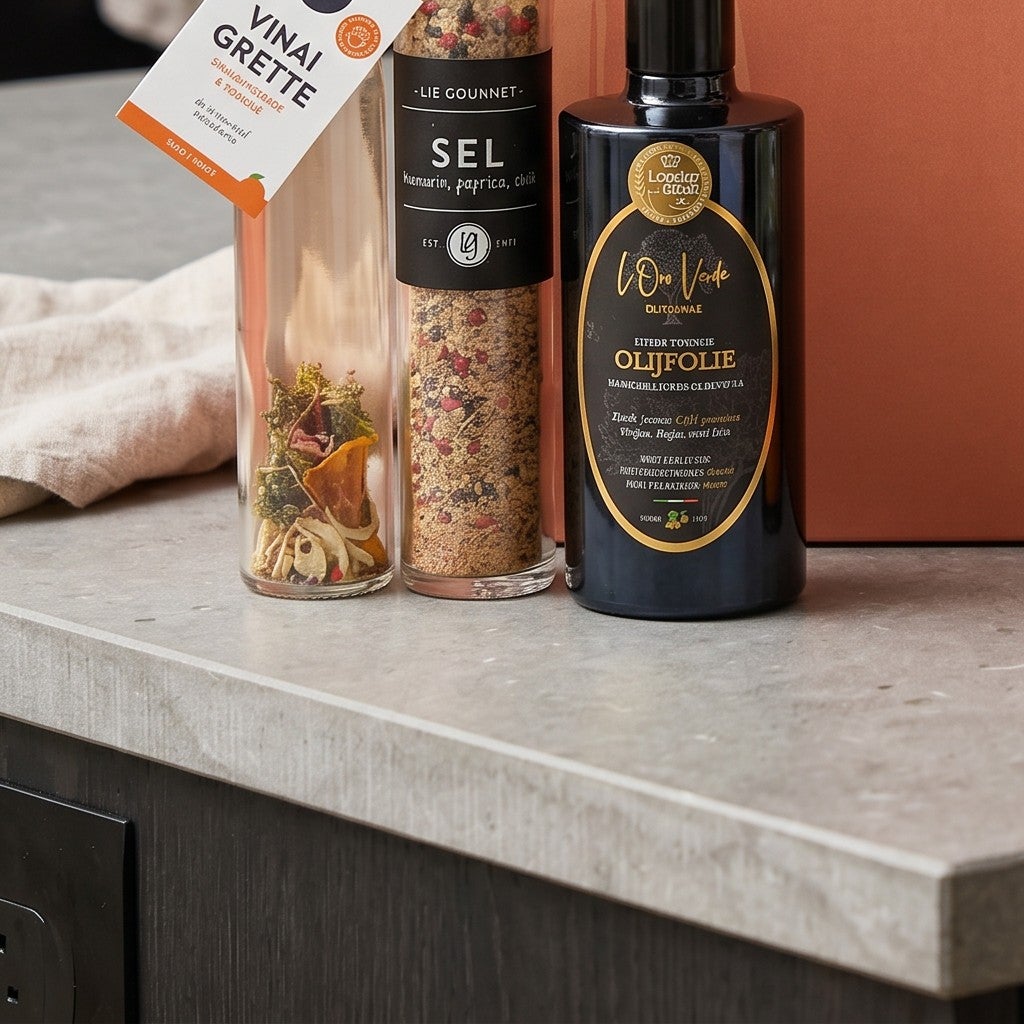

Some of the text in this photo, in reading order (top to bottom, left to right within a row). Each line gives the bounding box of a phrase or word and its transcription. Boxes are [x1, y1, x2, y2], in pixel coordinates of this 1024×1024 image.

[250, 4, 323, 73] VINAI
[212, 24, 318, 109] GRETTE
[420, 86, 440, 99] LIE
[431, 137, 504, 169] SEL
[681, 251, 731, 301] Verde
[614, 349, 737, 378] OLIJFOLIE
